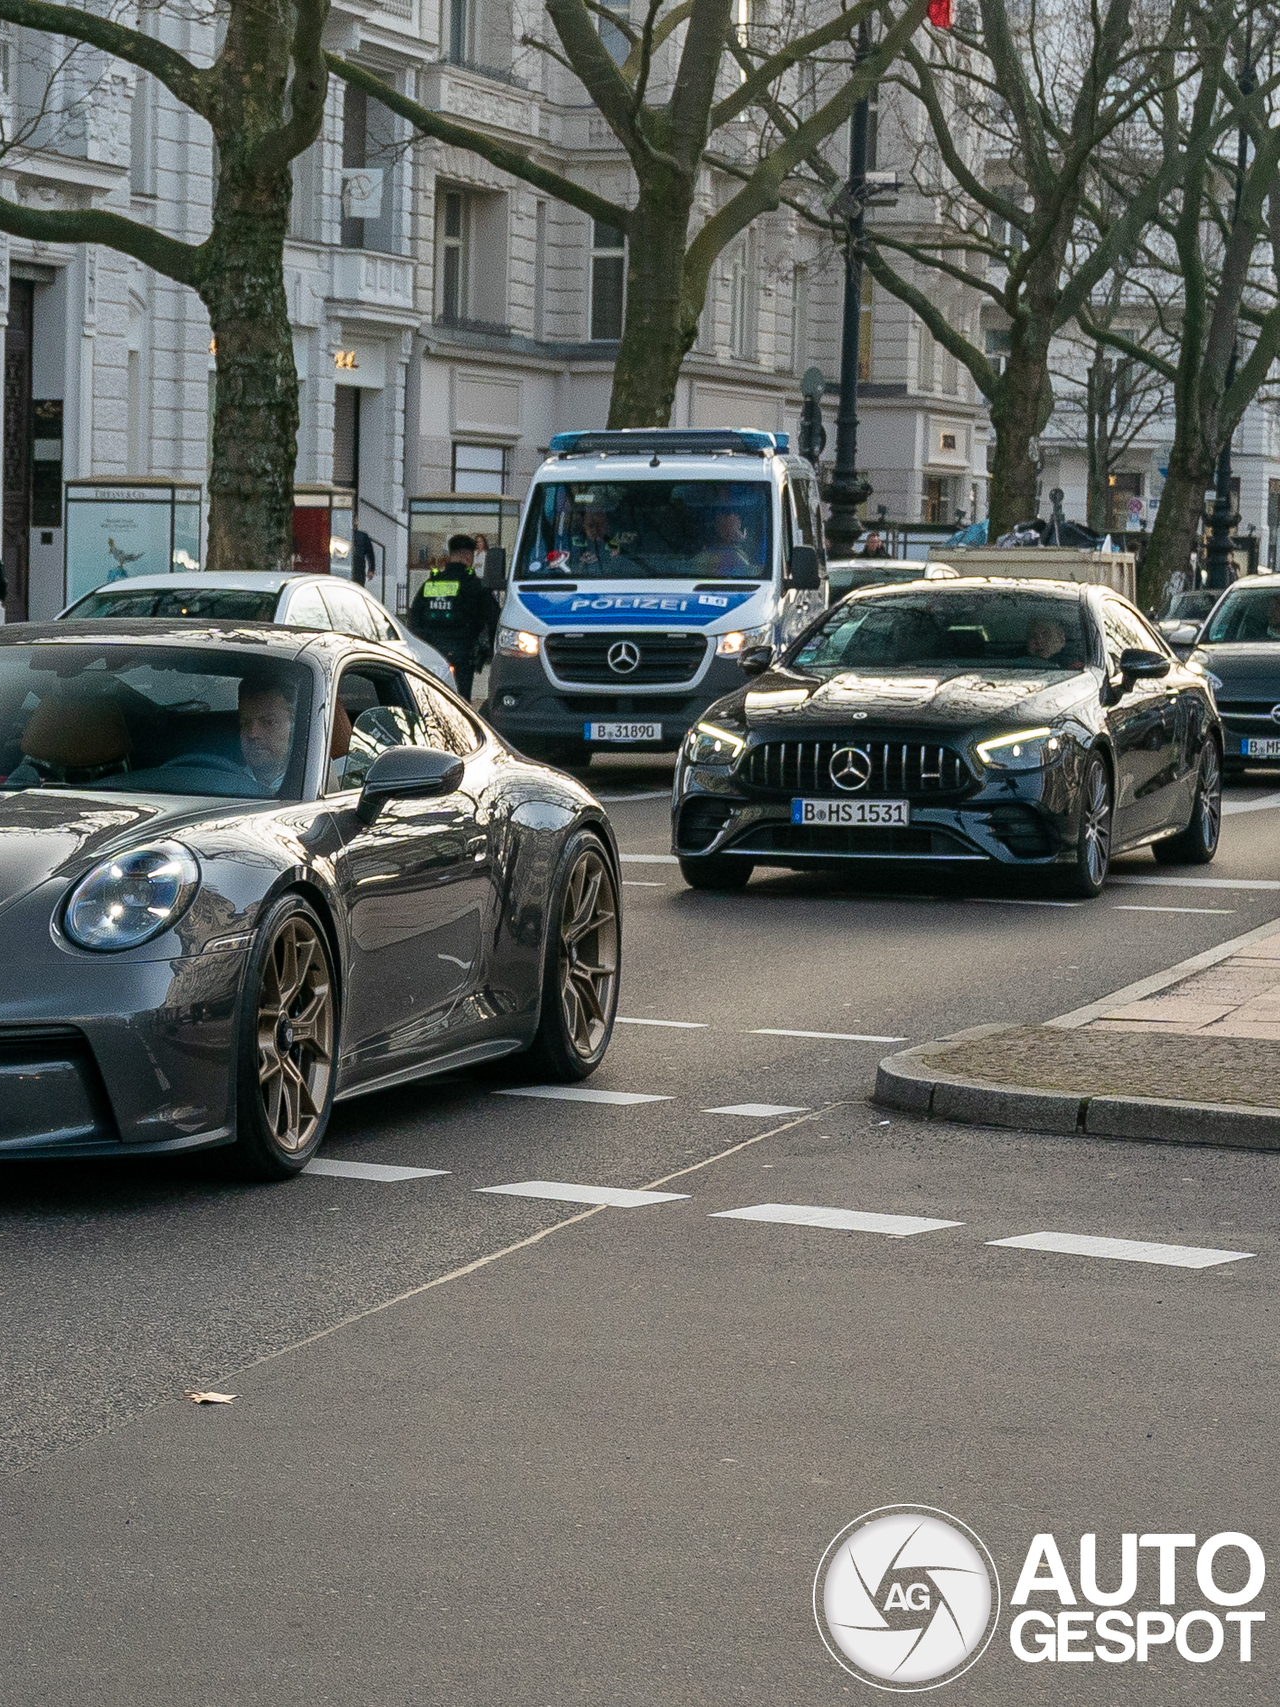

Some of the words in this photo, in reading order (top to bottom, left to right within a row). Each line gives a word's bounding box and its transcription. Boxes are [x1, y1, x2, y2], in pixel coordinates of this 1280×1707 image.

[571, 598, 689, 612] POLIZEI
[597, 725, 607, 738] B
[614, 725, 655, 738] 31890
[1249, 741, 1258, 753] B
[804, 803, 815, 821] B
[828, 803, 852, 822] HS
[856, 804, 904, 823] 1531
